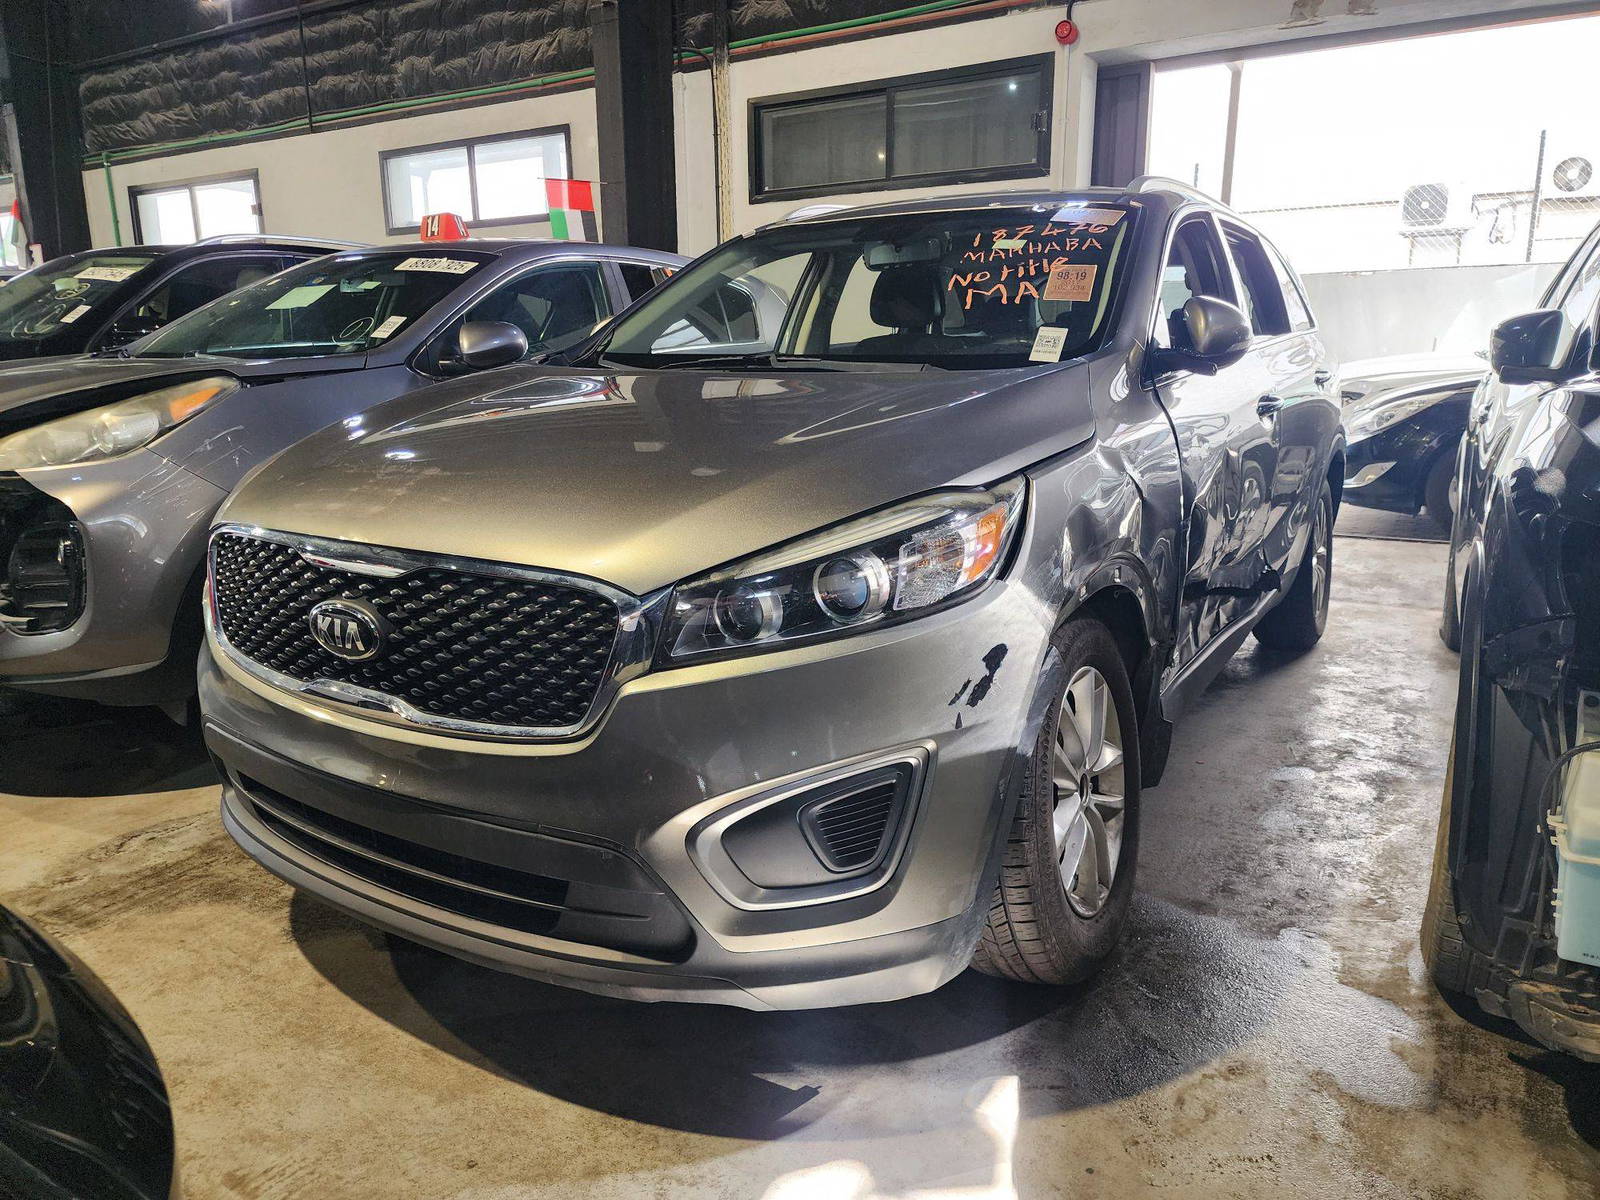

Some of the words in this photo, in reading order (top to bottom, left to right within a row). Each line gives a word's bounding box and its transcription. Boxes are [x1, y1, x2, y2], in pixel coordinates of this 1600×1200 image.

[426, 215, 440, 236] 14
[964, 281, 1039, 309] MA
[318, 614, 366, 651] KIA
